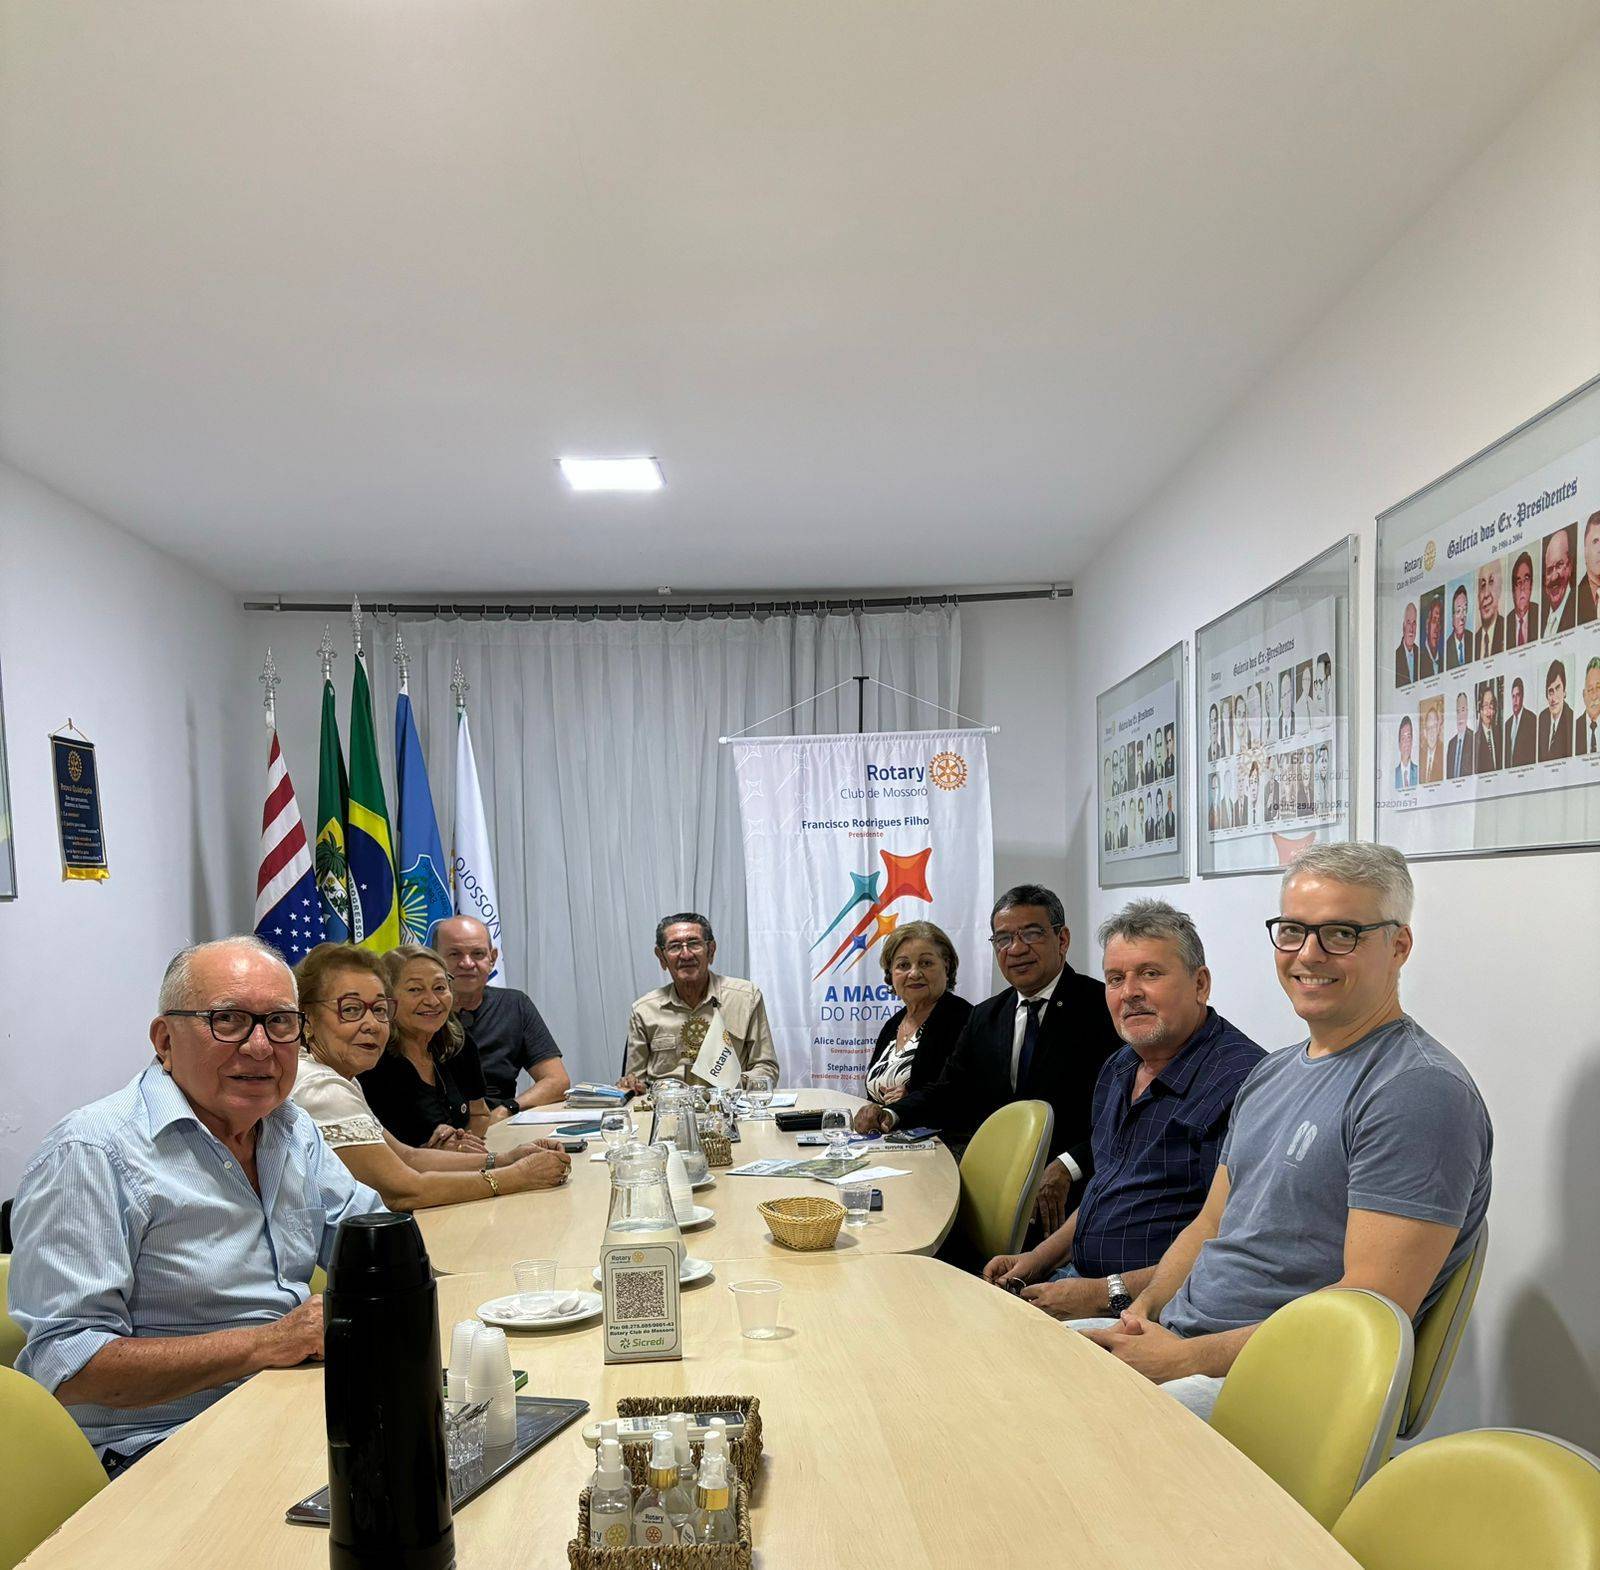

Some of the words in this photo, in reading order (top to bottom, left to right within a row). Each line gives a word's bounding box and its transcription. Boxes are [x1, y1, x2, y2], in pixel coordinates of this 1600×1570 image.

[1447, 530, 1478, 559] Galeria
[1480, 520, 1496, 541] dos
[1498, 476, 1578, 535] Ex-Presidentes
[867, 764, 925, 782] Rotary
[840, 788, 865, 799] Club
[867, 788, 880, 799] de
[883, 786, 928, 798] Mossoró
[802, 819, 849, 830] Francisco
[852, 817, 901, 830] Rodrigues
[904, 816, 929, 826] Filho
[825, 986, 838, 1002] A
[844, 985, 902, 1002] MAG
[821, 1006, 844, 1021] DO
[850, 1006, 902, 1021] ROTA
[710, 1047, 732, 1077] Rotary
[827, 1063, 866, 1073] Stephanie
[632, 1337, 664, 1347] Sicredi
